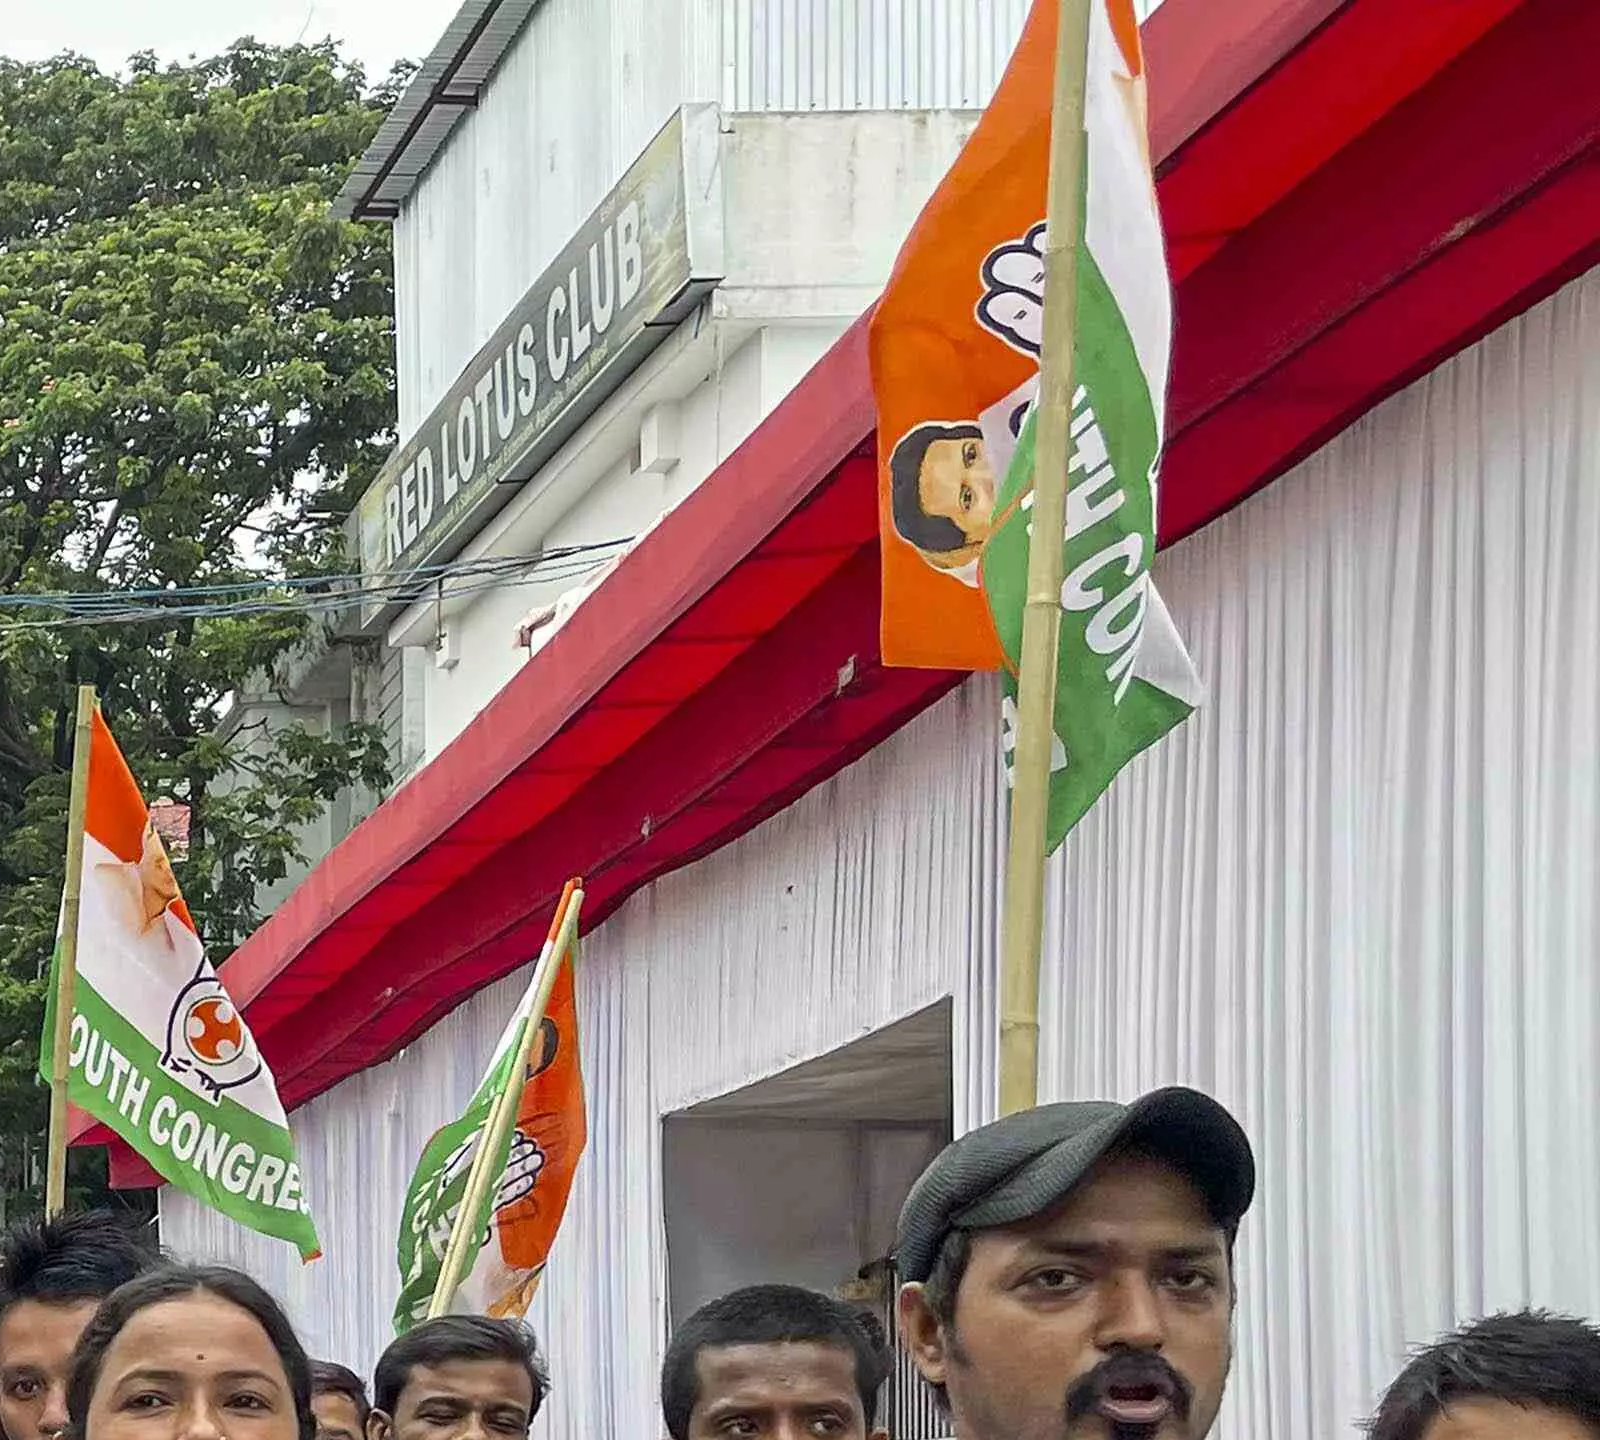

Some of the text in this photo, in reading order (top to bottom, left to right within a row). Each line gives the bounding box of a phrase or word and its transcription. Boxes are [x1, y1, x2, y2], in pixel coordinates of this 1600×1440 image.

[386, 447, 434, 567] RED
[441, 323, 538, 505] LOTUS
[546, 201, 642, 382] CLUB
